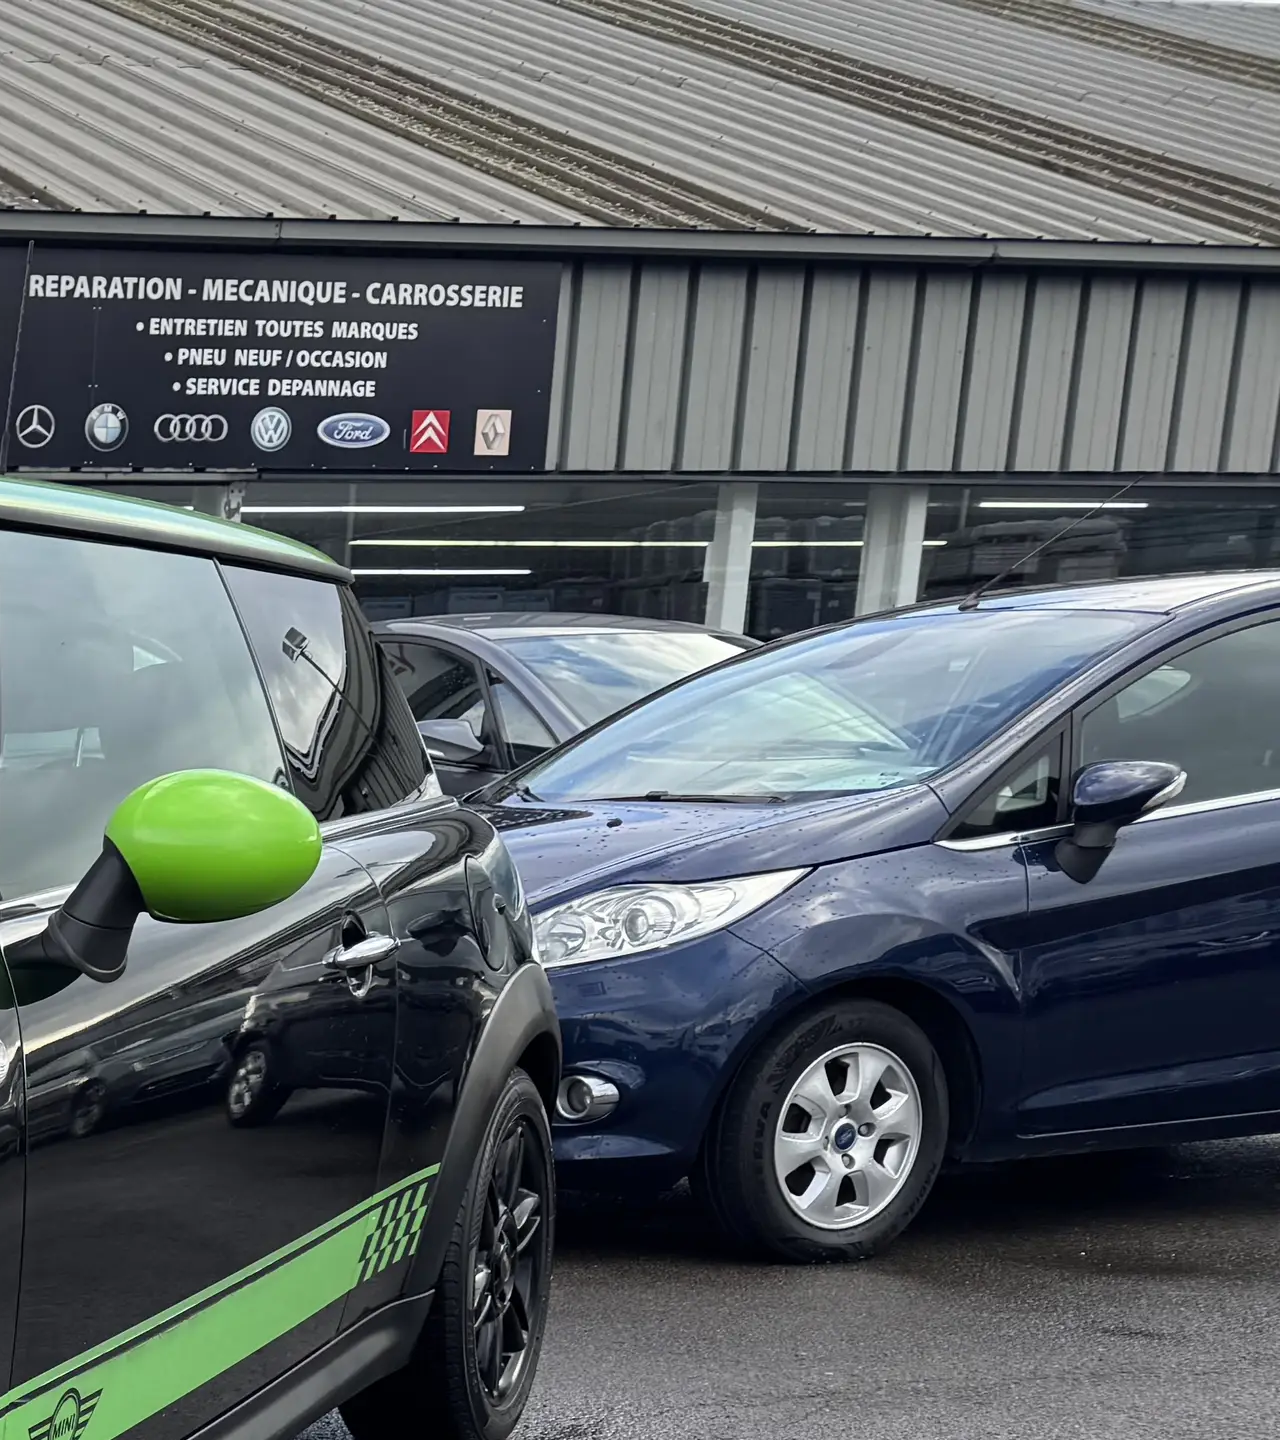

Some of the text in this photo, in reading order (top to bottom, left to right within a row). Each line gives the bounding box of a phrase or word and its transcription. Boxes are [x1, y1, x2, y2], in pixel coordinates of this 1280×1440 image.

[28, 274, 183, 300] REPARATION
[201, 278, 347, 306] MECANIQUE
[365, 281, 524, 308] CARROSSERIE
[148, 317, 419, 341] ENTRETIEN TOUTES MARQUES
[177, 347, 227, 366] PNEU
[185, 377, 377, 397] SERVICE DEPANNAGE
[332, 420, 374, 441] Ford
